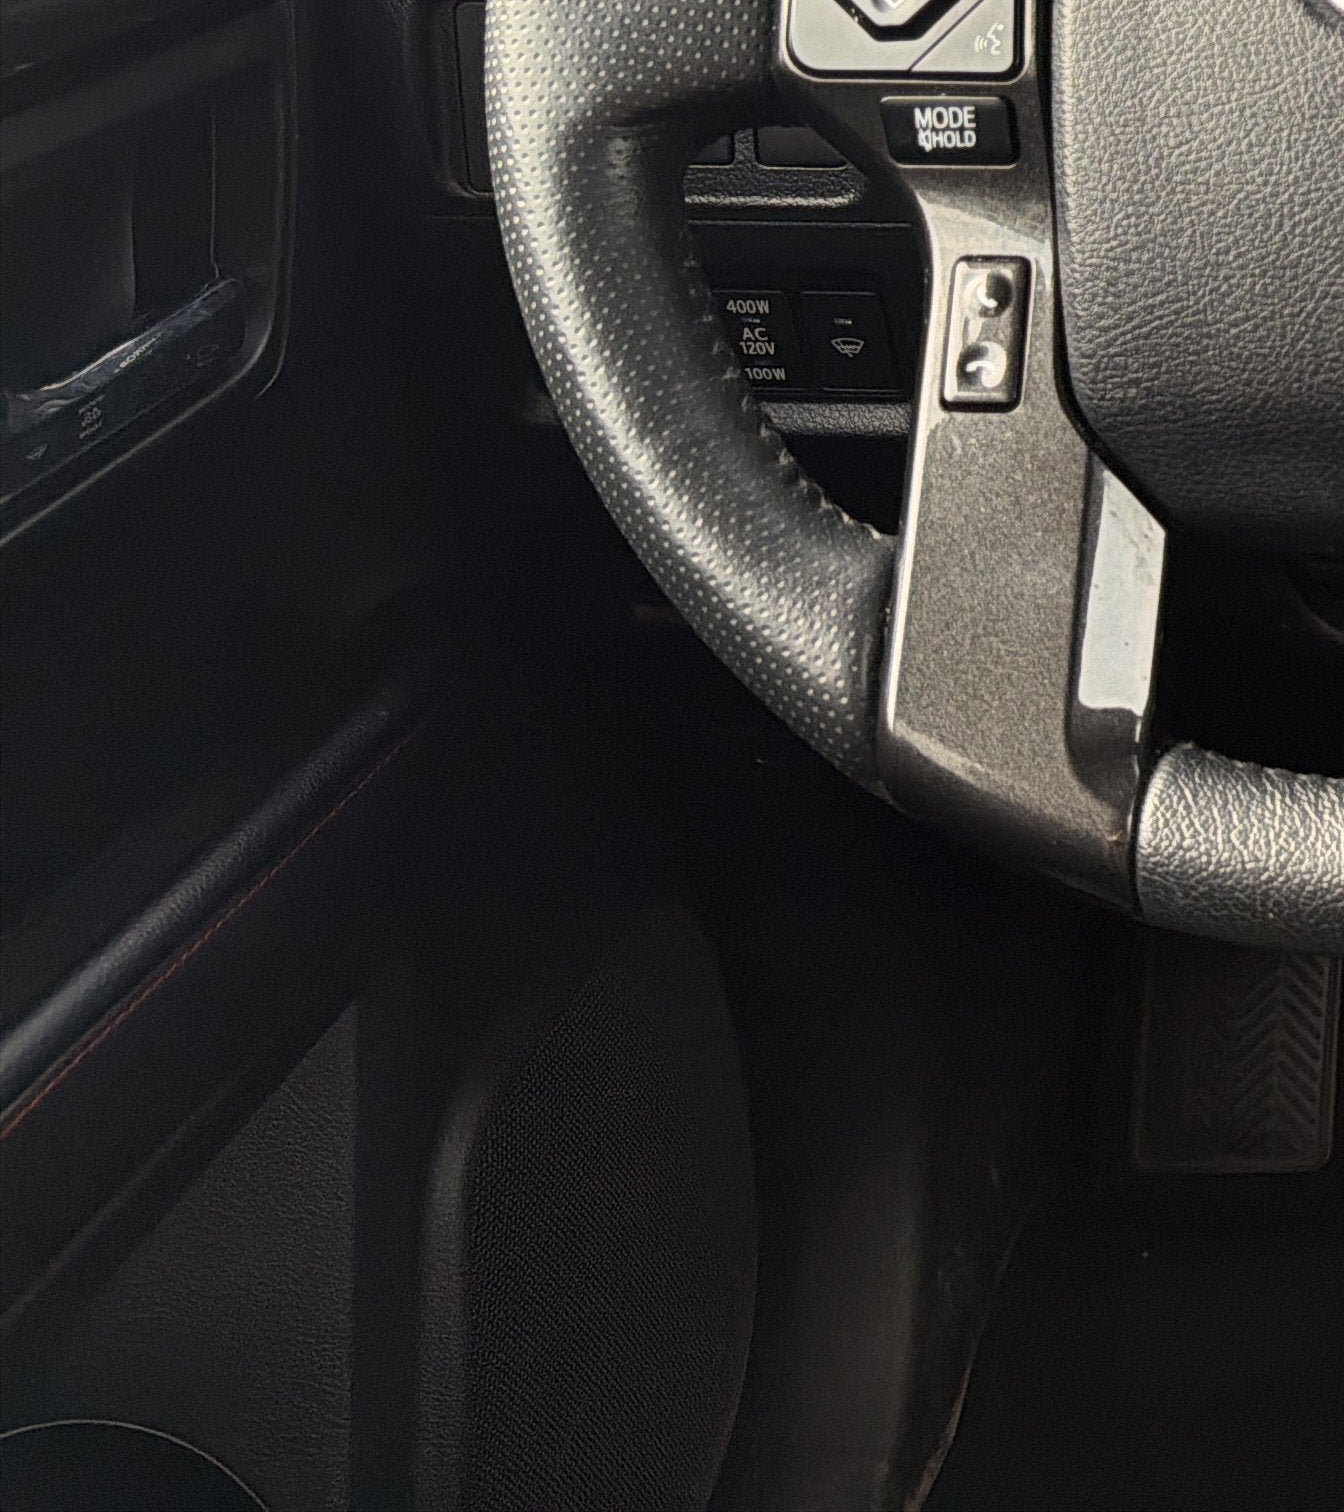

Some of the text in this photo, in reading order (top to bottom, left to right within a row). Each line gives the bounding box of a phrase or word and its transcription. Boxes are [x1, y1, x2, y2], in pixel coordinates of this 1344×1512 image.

[914, 106, 976, 130] MODE
[932, 130, 976, 149] HOLD
[726, 299, 770, 315] 400W
[742, 327, 769, 341] AC
[739, 342, 776, 356] 120V
[744, 367, 786, 381] 100W
